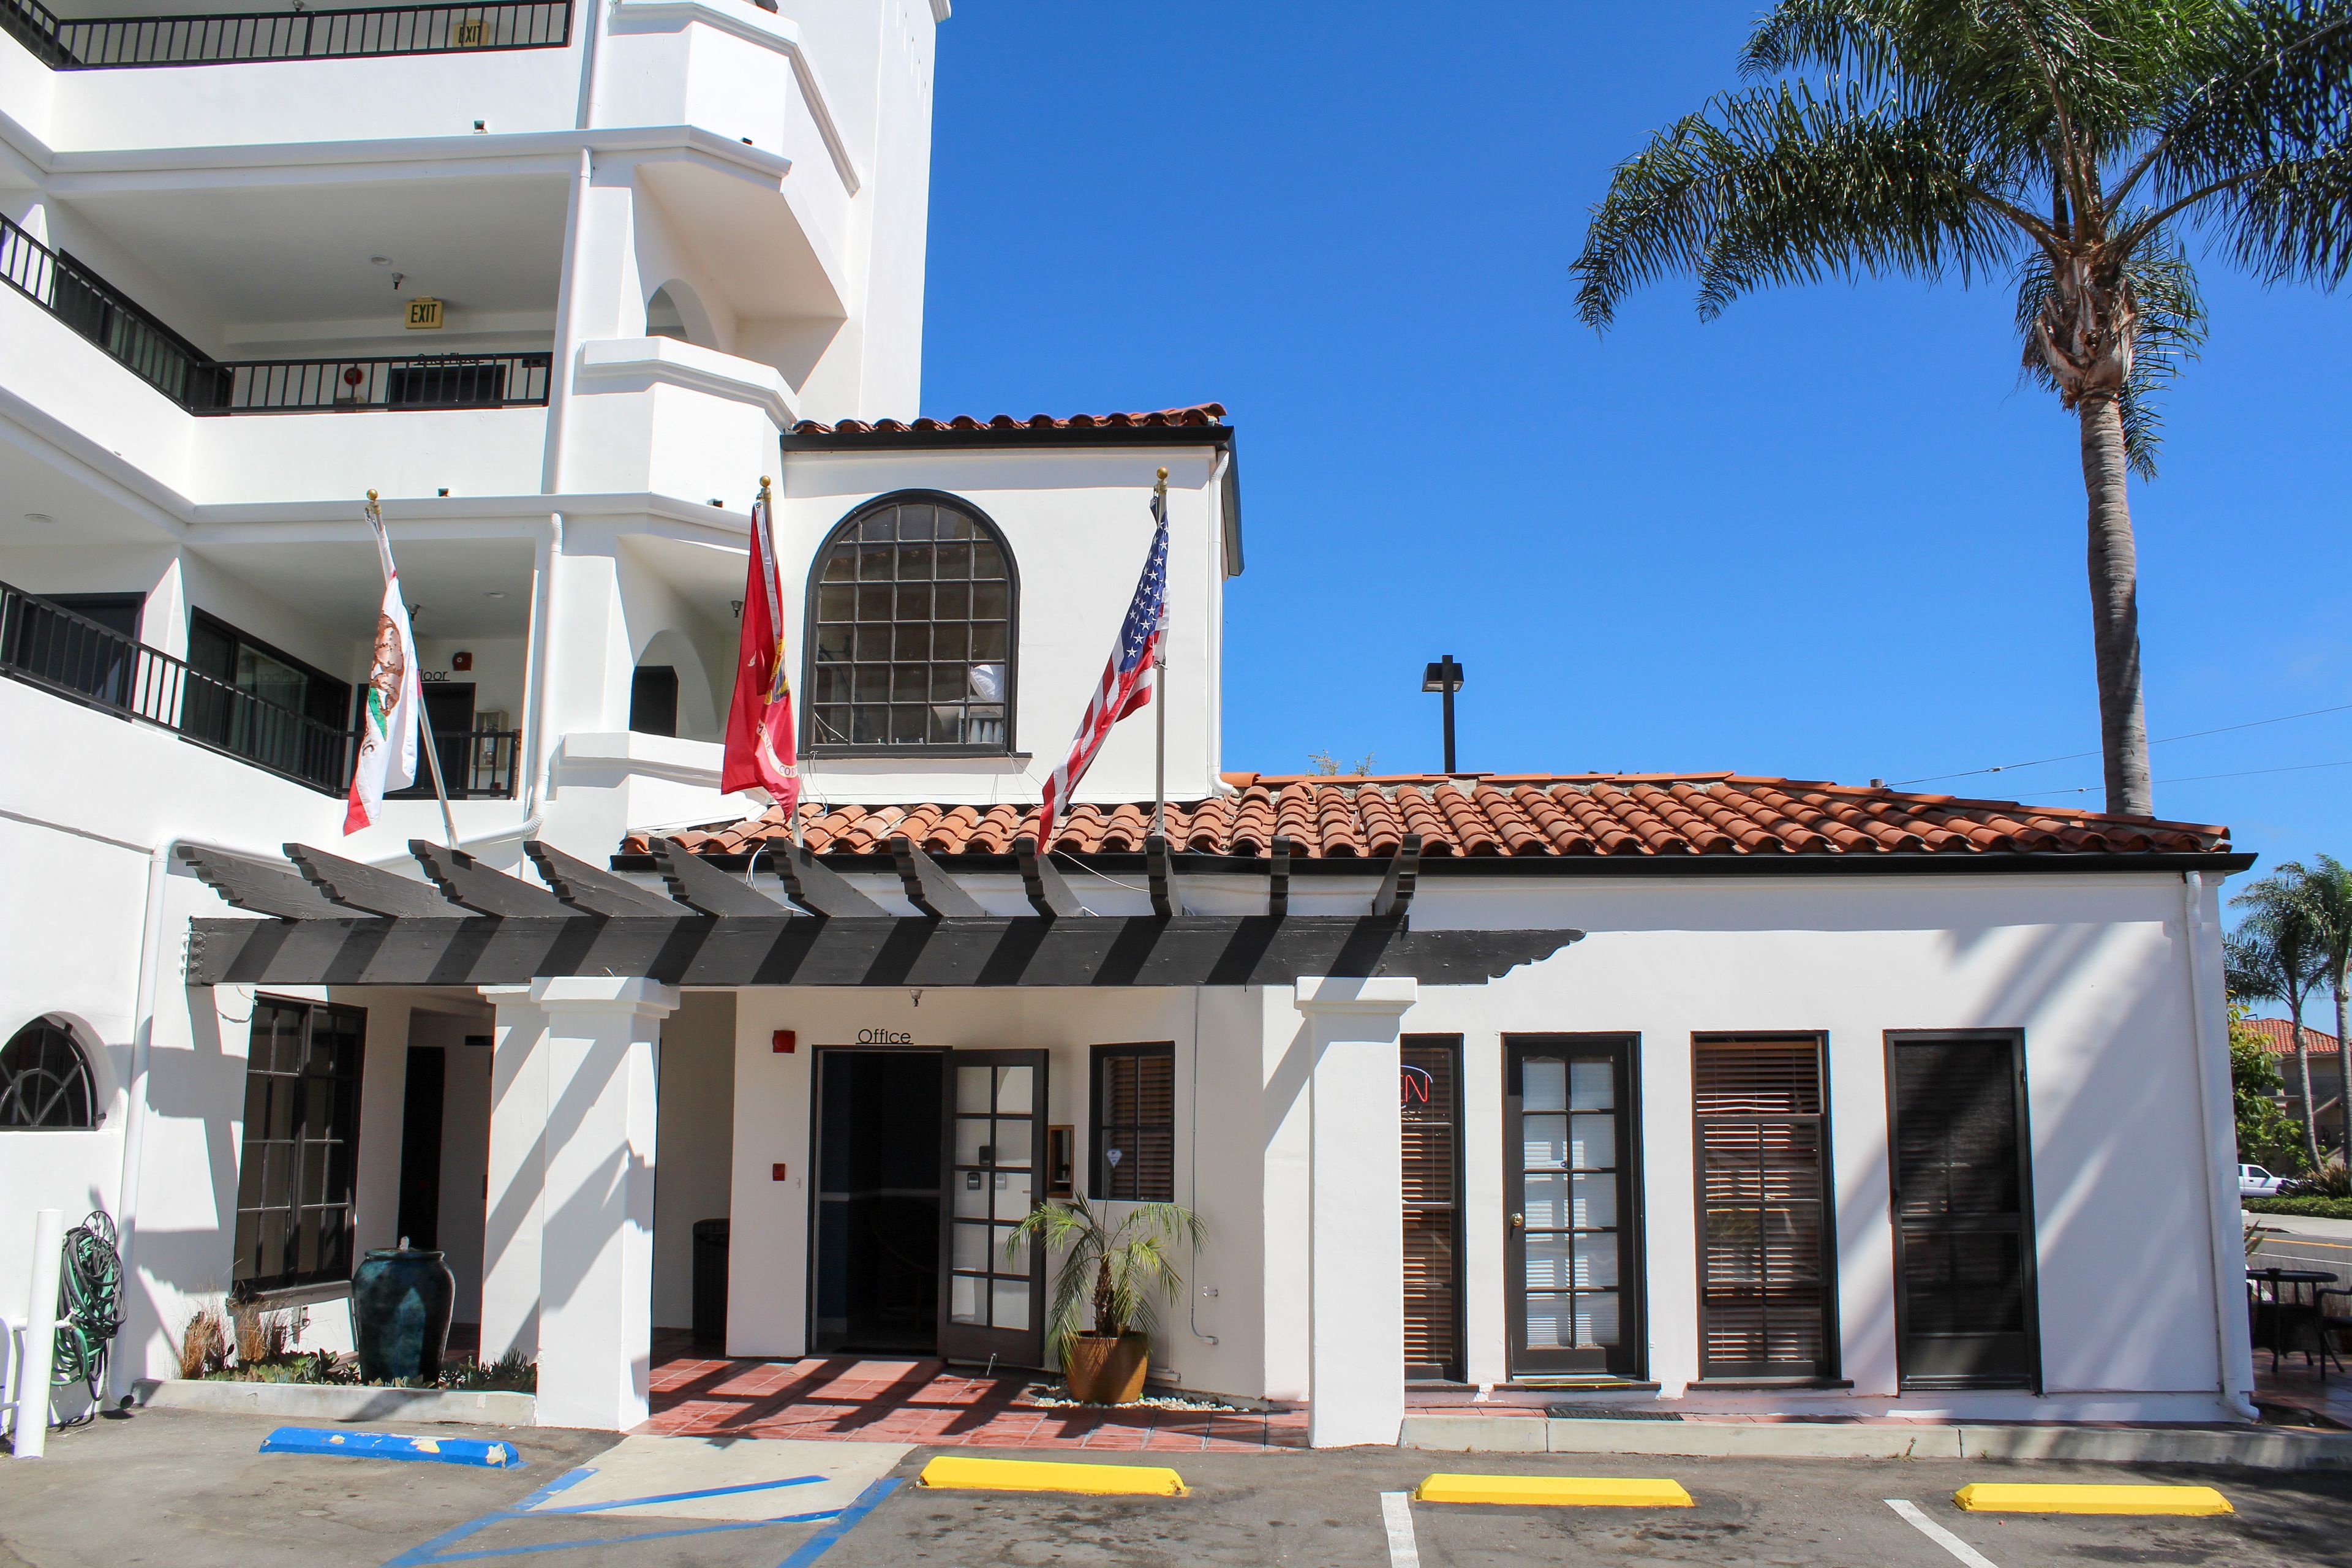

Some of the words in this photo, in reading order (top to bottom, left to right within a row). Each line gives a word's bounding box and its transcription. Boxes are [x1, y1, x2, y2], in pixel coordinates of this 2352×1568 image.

[411, 304, 437, 323] EXIT
[418, 668, 448, 680] loor
[858, 1029, 911, 1044] Office
